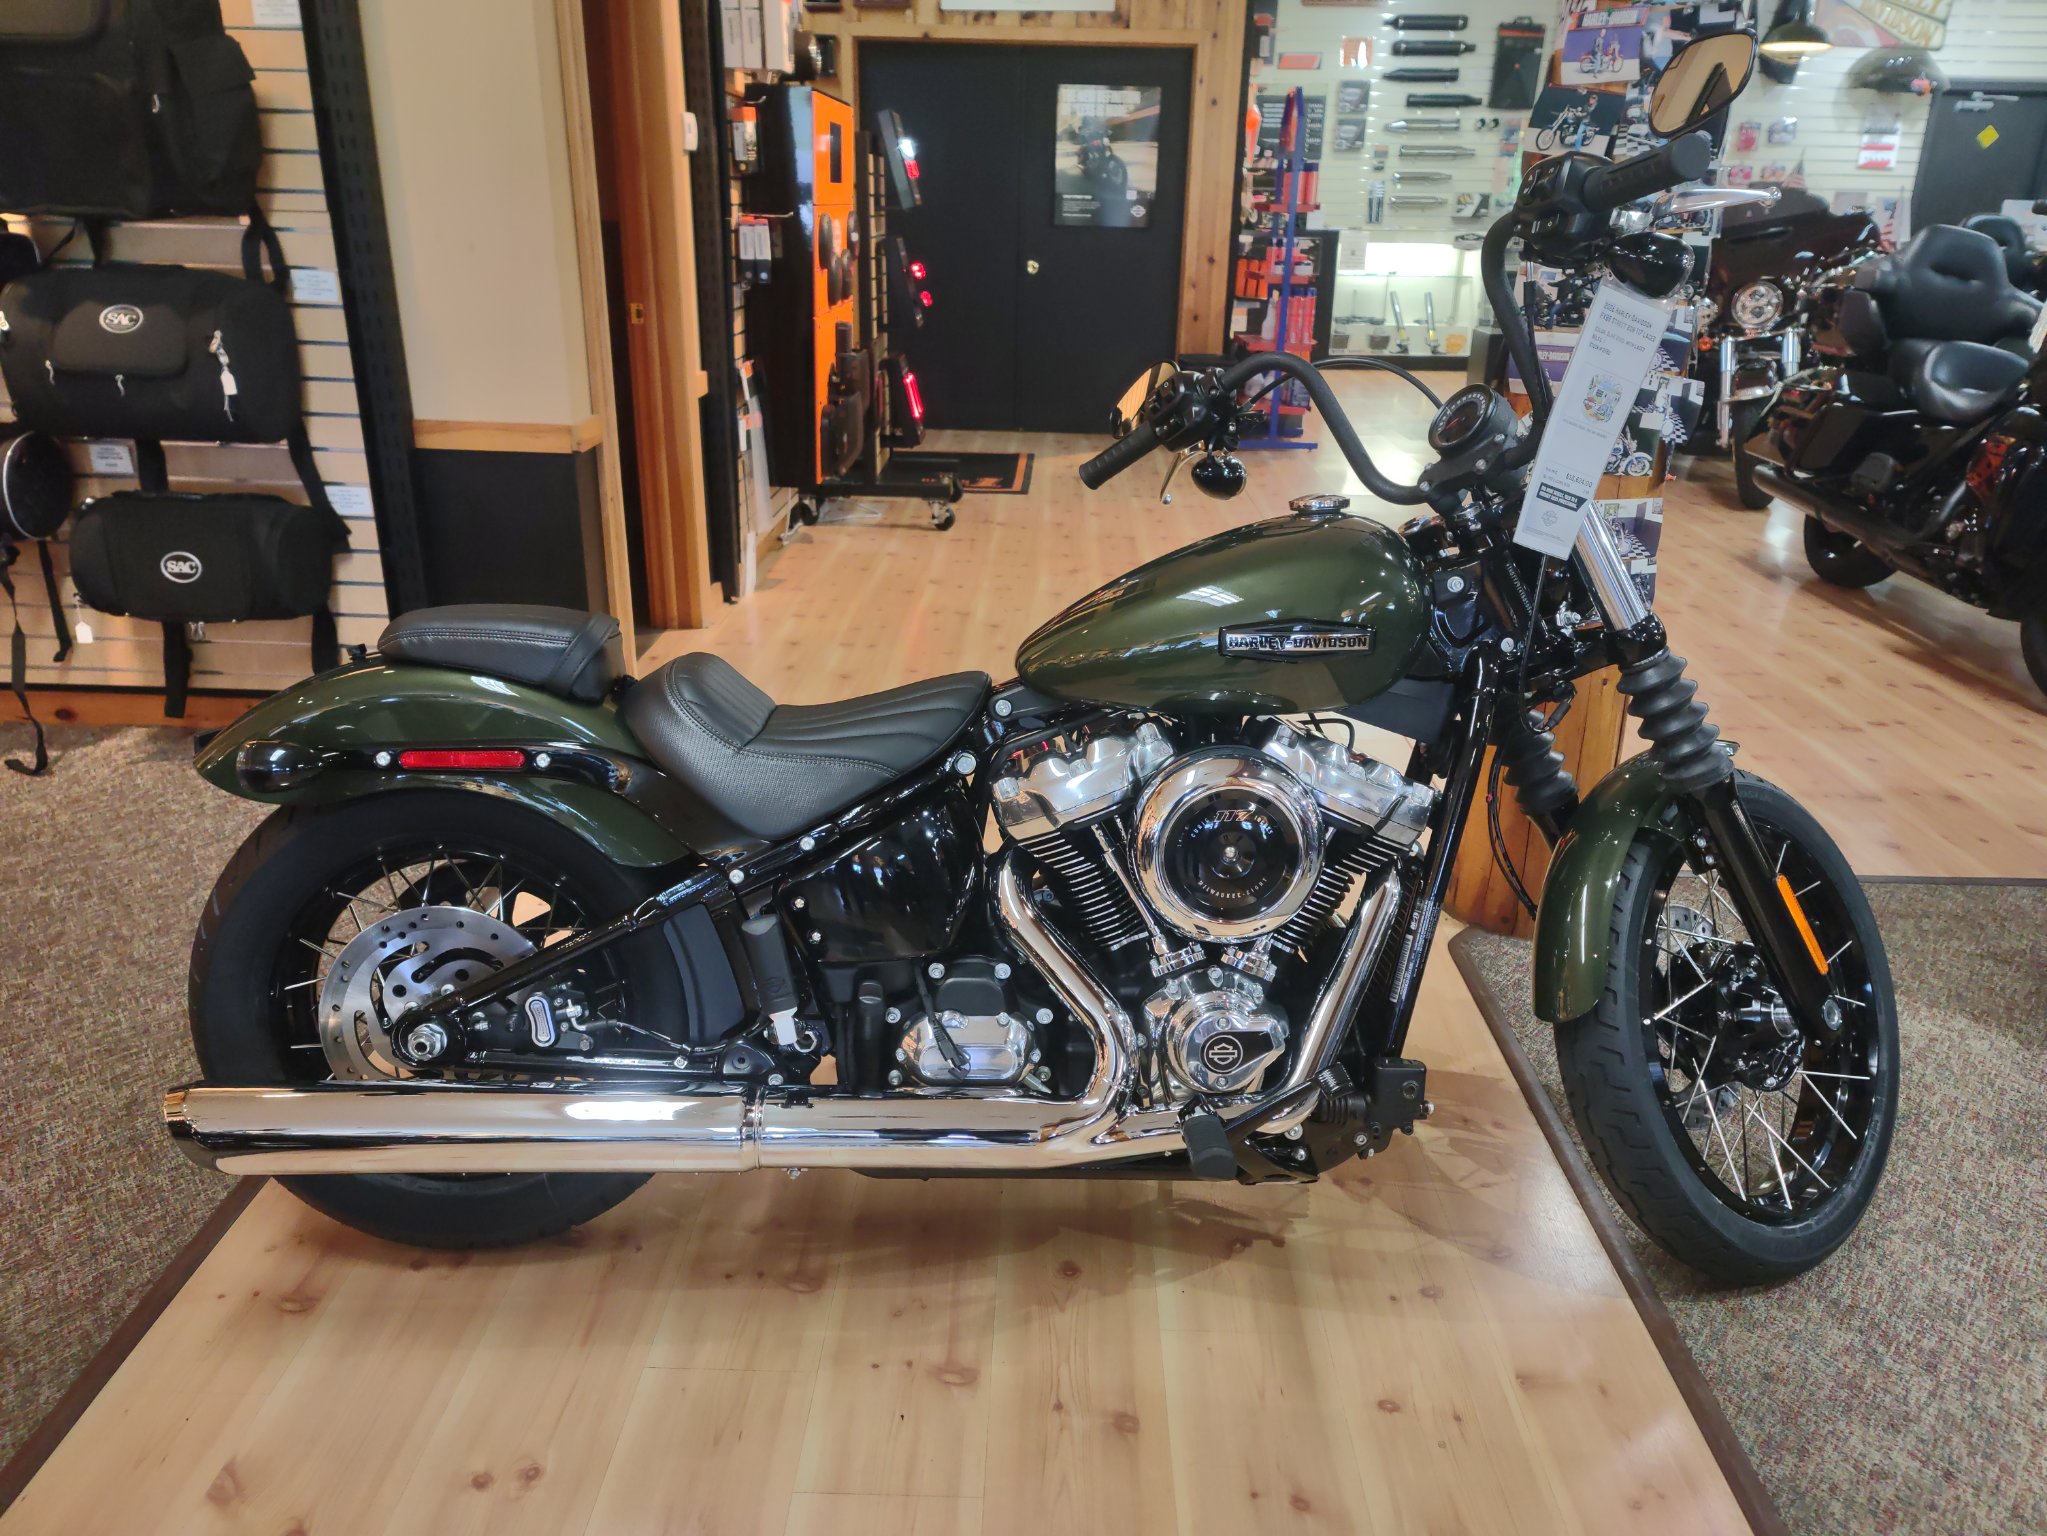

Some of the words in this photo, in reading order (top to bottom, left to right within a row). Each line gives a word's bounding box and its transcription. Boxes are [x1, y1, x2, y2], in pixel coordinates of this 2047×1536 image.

[106, 311, 136, 325] SAC
[166, 560, 196, 574] SAC
[1229, 636, 1367, 650] HARLEY-DAVIDSON
[1214, 809, 1255, 822] 117
